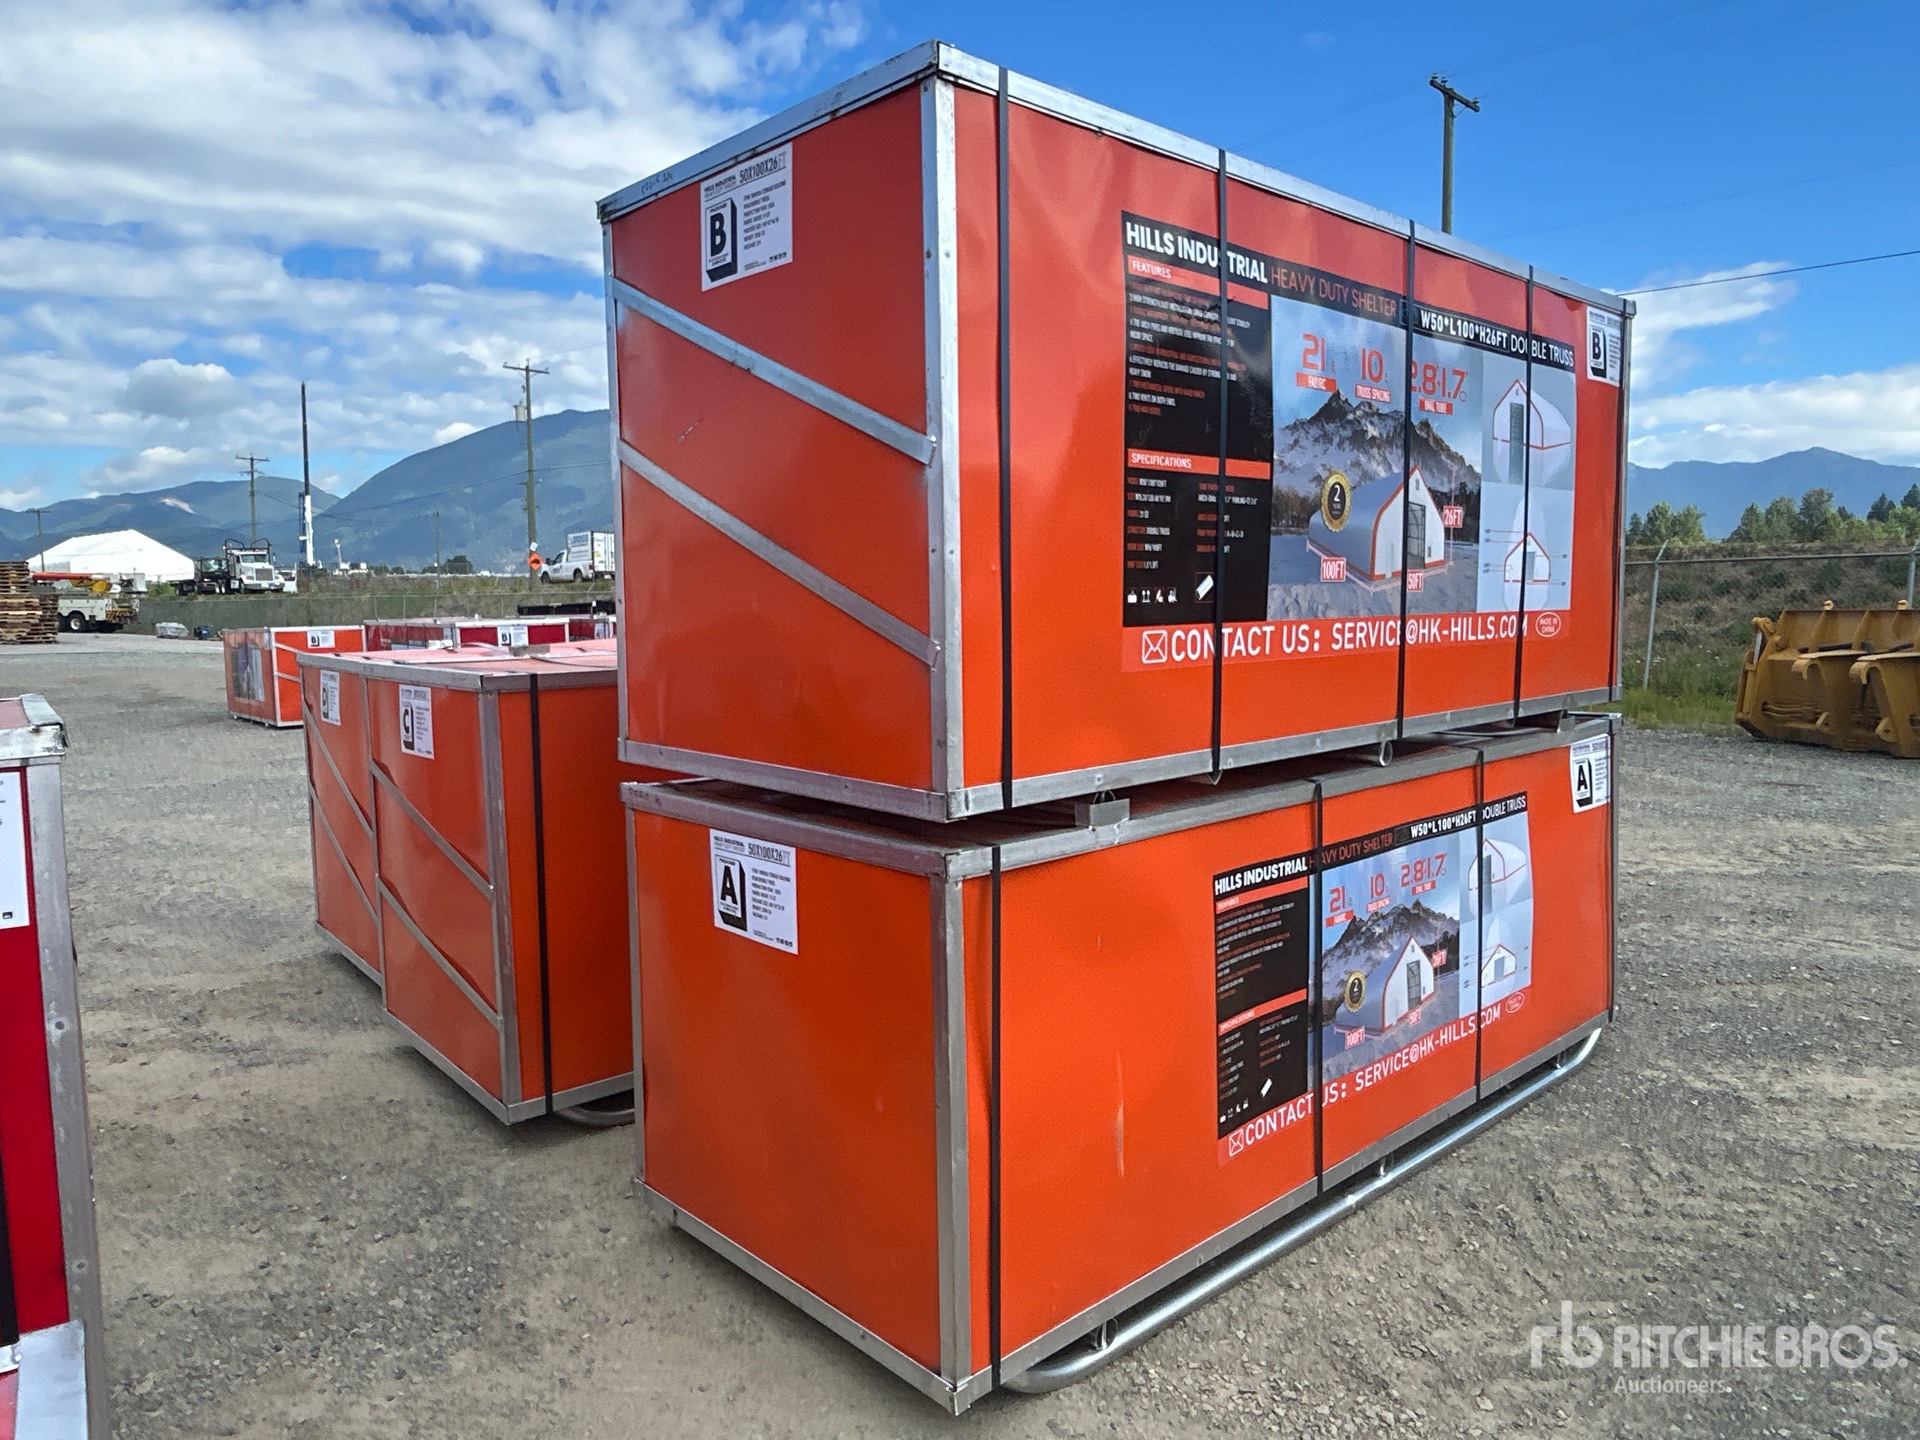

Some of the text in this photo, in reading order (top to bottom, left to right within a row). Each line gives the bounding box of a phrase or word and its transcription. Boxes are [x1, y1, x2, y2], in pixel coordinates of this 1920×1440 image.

[710, 213, 727, 257] B
[1126, 221, 1397, 318] HILLS INDUTRIAL HEAVY DUTY SHELTER
[1131, 259, 1172, 279] FEATURES
[1302, 333, 1326, 371] 21
[1549, 343, 1574, 367] TRUSS
[1592, 331, 1601, 361] B
[1361, 347, 1384, 384] 10
[1131, 452, 1192, 469] SPECIFICATIONS
[1333, 484, 1341, 502] 2
[1444, 506, 1463, 527] 26FT
[1322, 560, 1345, 581] 100FT
[1407, 573, 1423, 592] 50FT
[1171, 625, 1275, 662] CONTACT
[1283, 624, 1320, 654] US:
[403, 708, 410, 735] C
[1577, 765, 1588, 791] A
[1507, 795, 1526, 812] TRUSS
[1215, 831, 1393, 896] HILLS INDUSTRIAL HAVY DUTY SHELTER
[720, 865, 738, 905] A
[1370, 873, 1385, 899] 10
[1329, 885, 1346, 913] 21
[1352, 980, 1359, 992] 2
[1346, 1028, 1366, 1047] 100FT
[1245, 1092, 1315, 1147] CONTACT
[1354, 1003, 1501, 1092] SERVICE@HK-HILLS.COM
